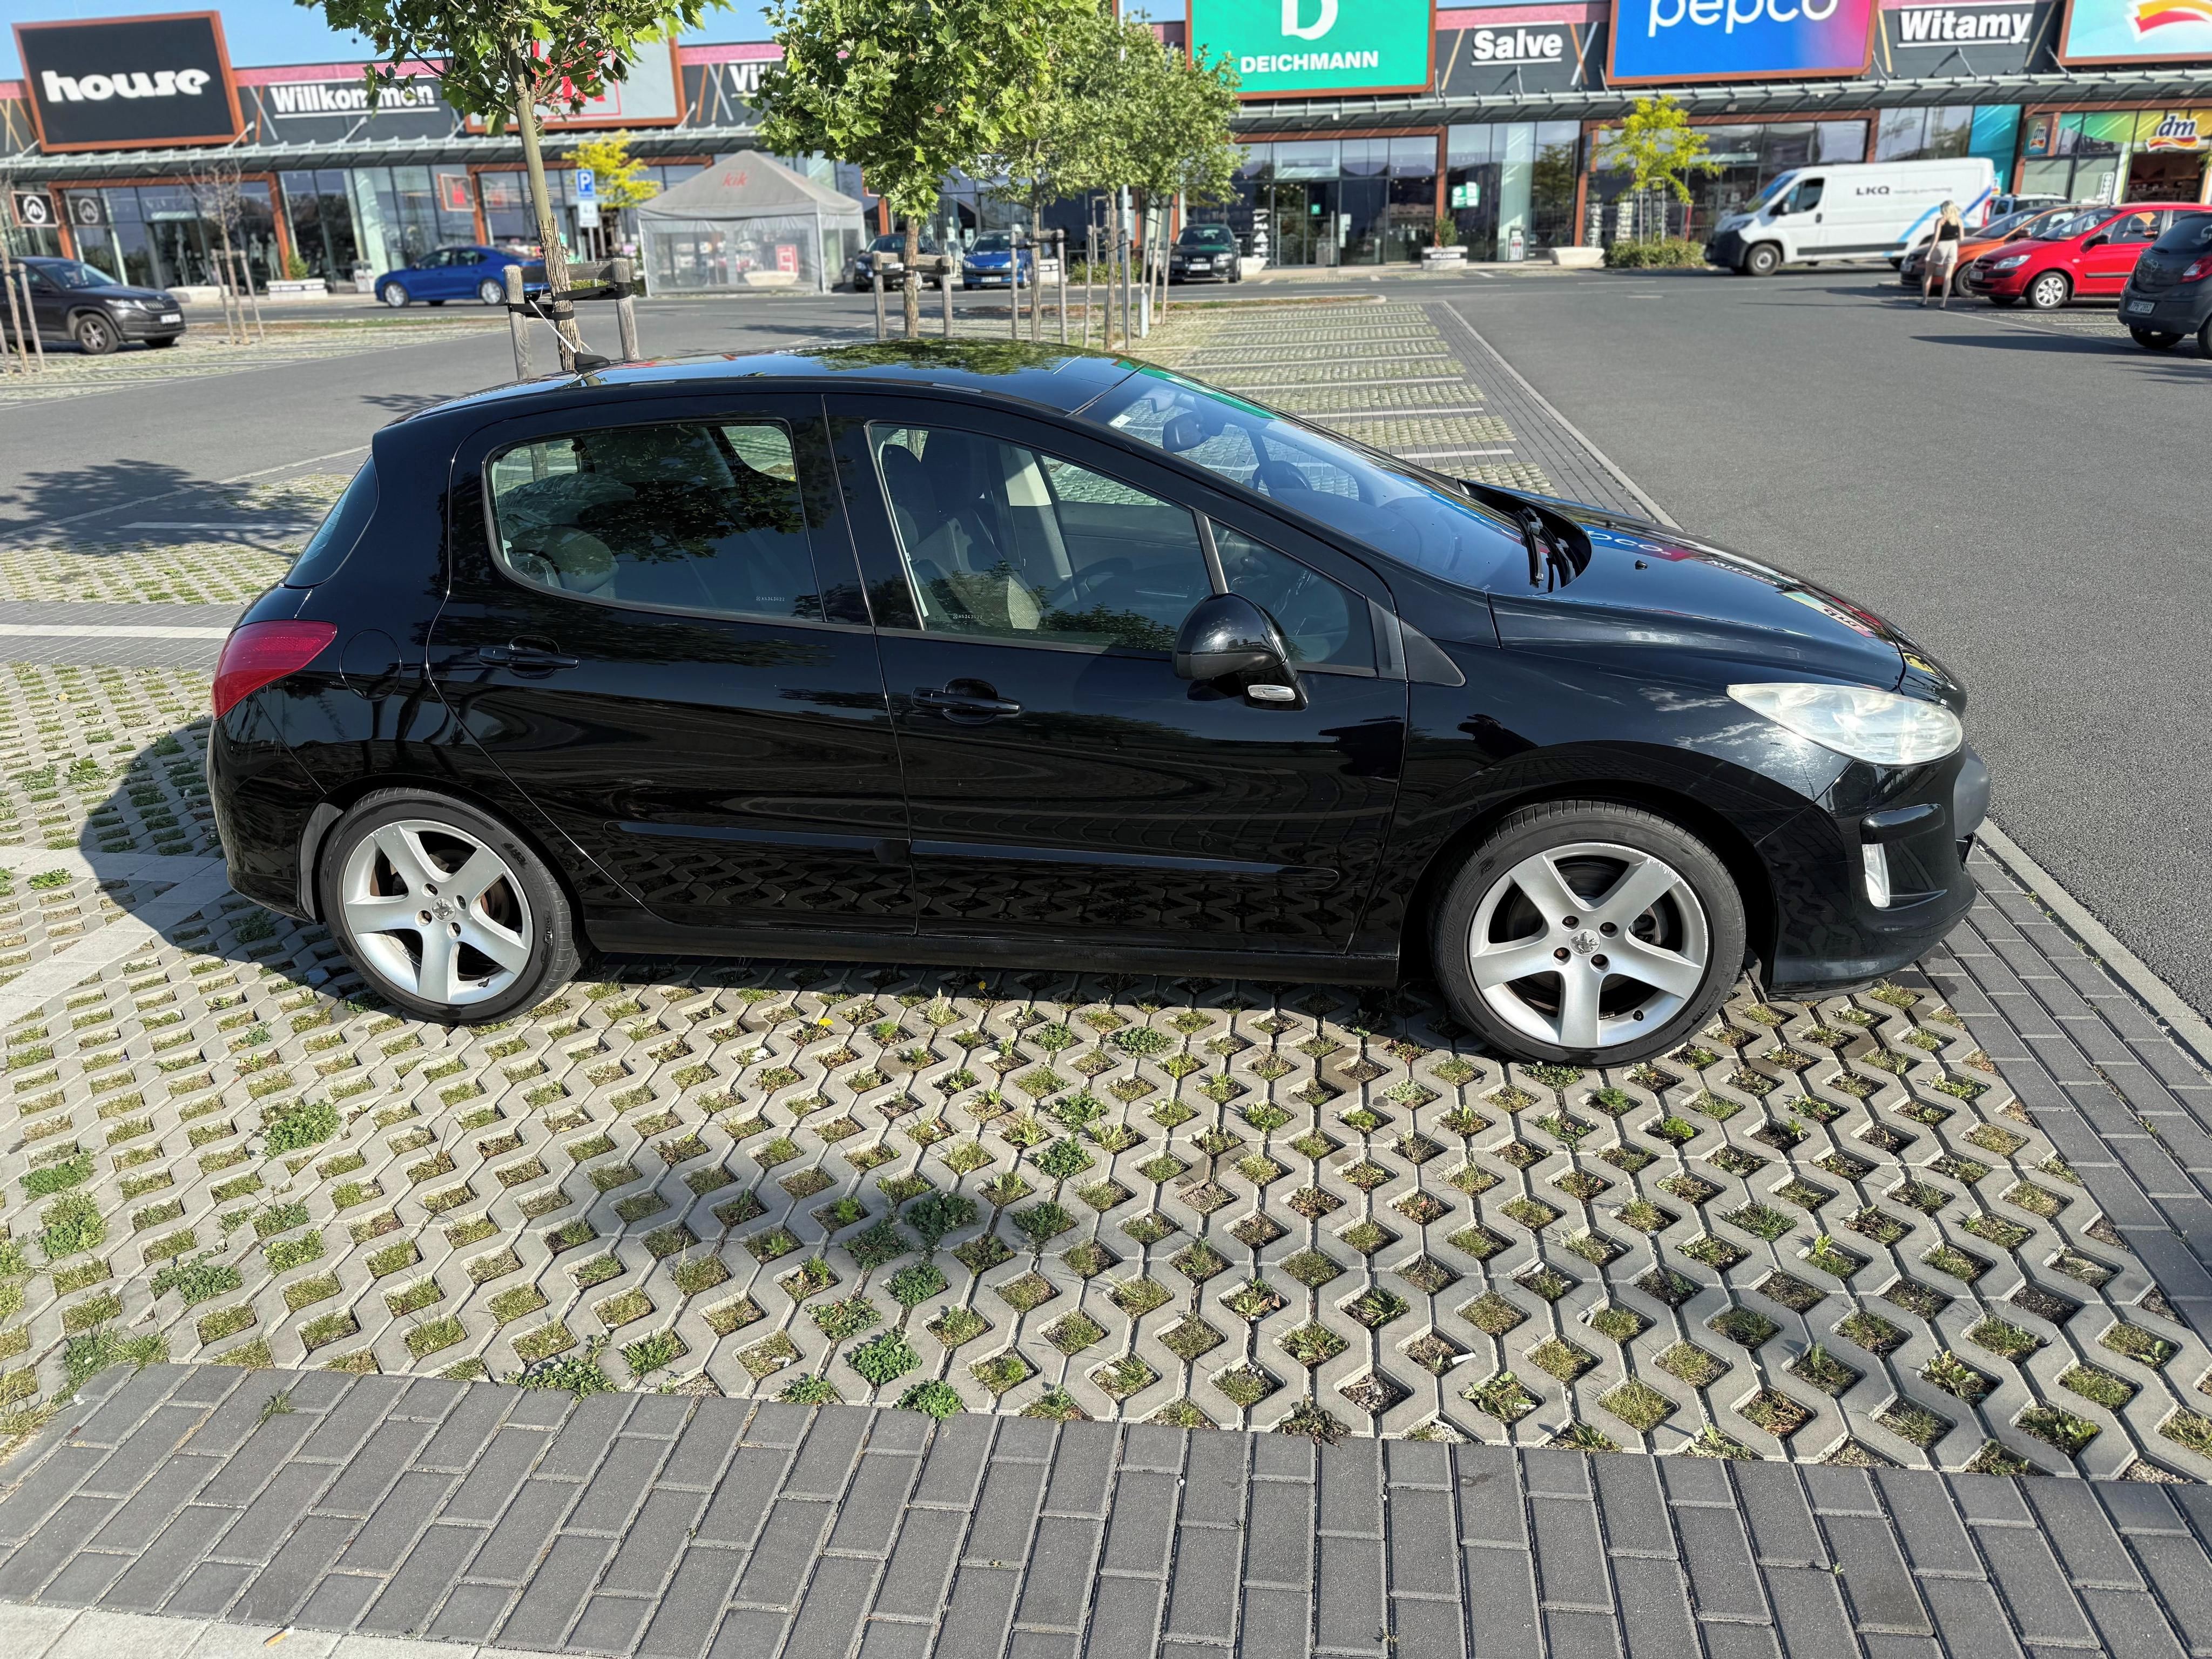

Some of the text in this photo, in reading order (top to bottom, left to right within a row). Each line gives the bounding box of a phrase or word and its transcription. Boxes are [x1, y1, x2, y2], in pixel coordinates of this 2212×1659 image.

[1648, 0, 1838, 37] pepco
[1900, 8, 2033, 43] Witamy
[1473, 29, 1562, 60] Salve
[1240, 50, 1378, 73] DEICHMANN
[41, 69, 211, 103] house
[2033, 122, 2046, 139] dm
[2157, 114, 2196, 137] dm
[580, 173, 591, 191] P
[1856, 186, 1890, 195] LKQ
